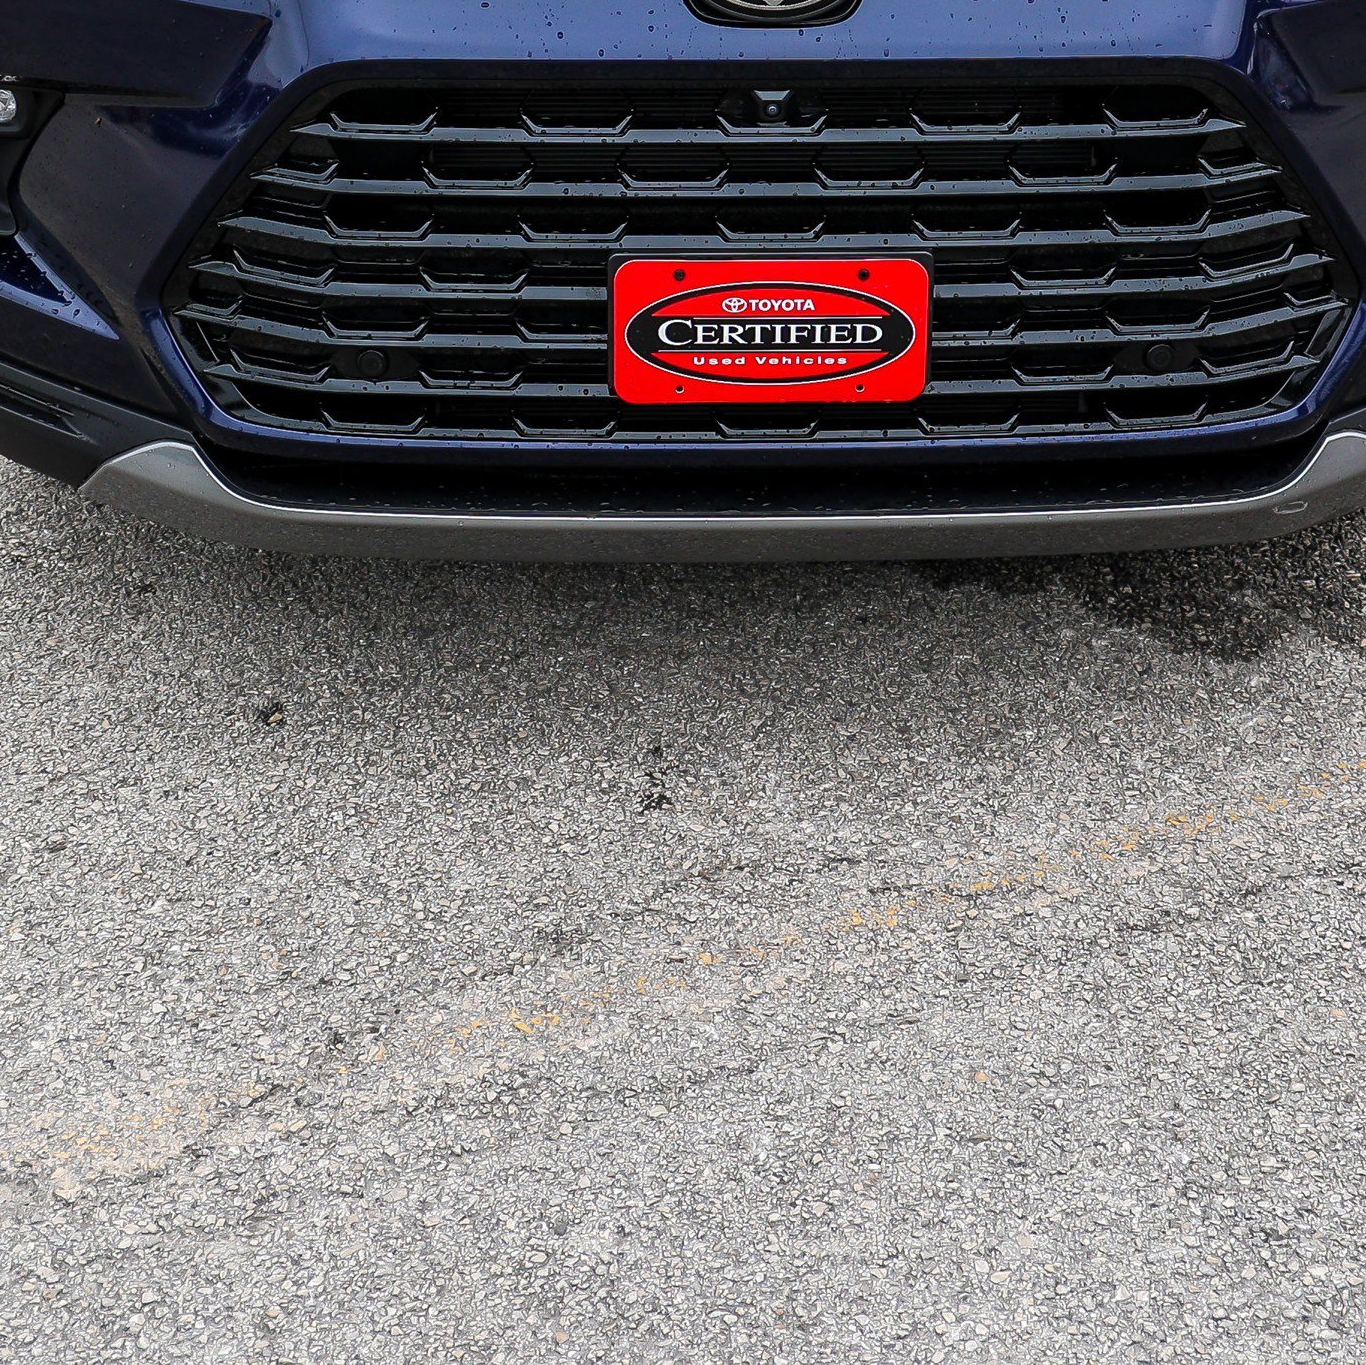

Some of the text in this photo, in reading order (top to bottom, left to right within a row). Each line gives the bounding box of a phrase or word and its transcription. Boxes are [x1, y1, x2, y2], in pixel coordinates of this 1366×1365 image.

[749, 299, 815, 312] TOYOTA
[657, 319, 883, 346] CERTIFIED
[693, 356, 847, 366] Used Vehicles
